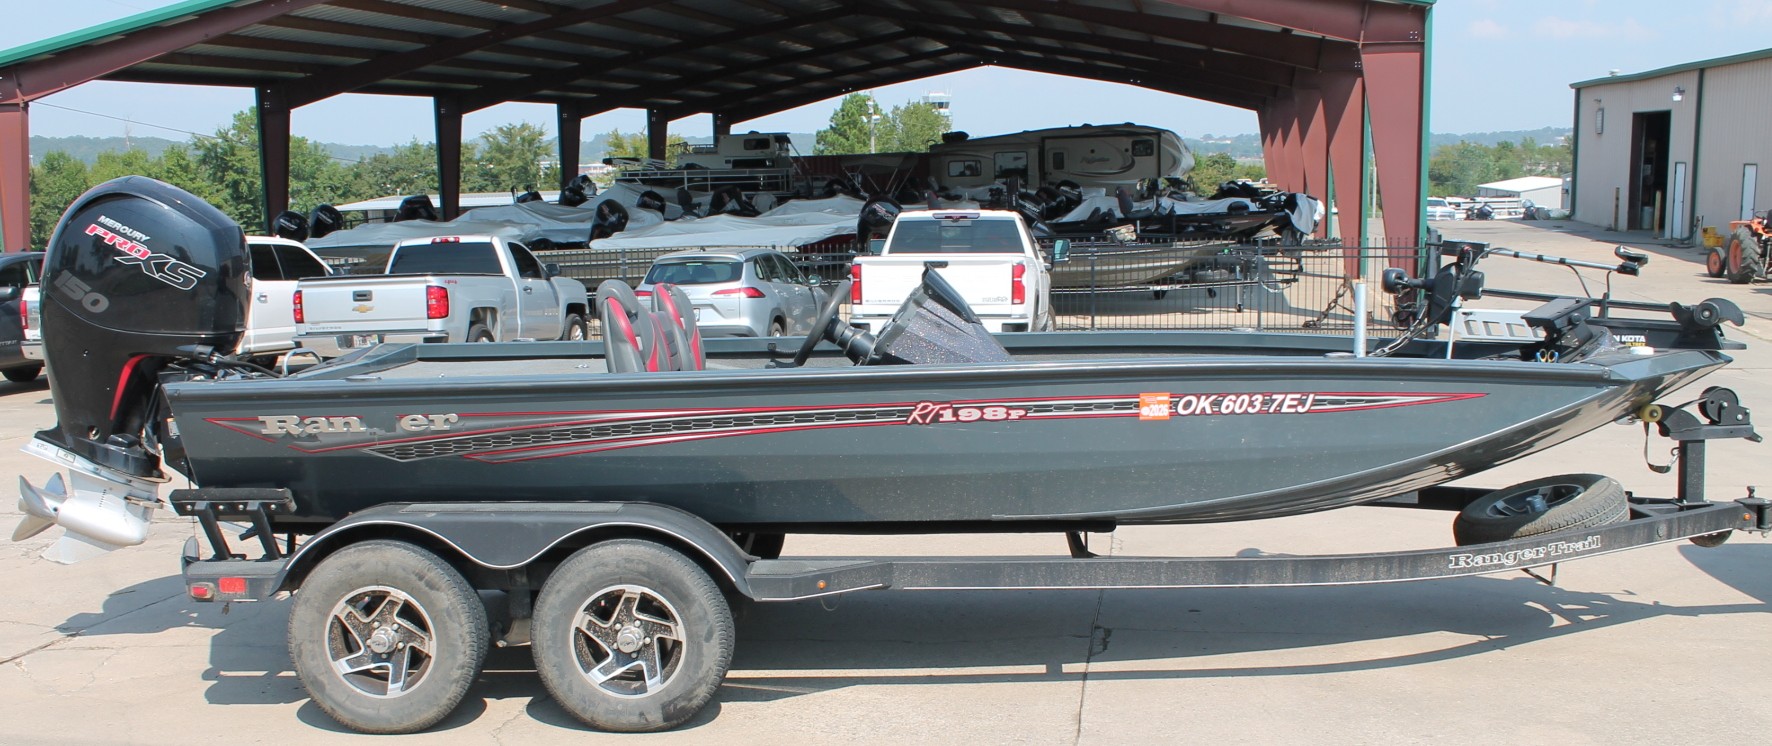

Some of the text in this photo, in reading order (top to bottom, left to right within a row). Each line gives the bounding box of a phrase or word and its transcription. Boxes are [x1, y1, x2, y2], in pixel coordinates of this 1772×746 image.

[85, 224, 151, 260] PRO
[98, 215, 150, 242] MERCURY
[54, 270, 109, 313] 150
[1176, 393, 1315, 416] OK 603 7EJ
[258, 411, 459, 435] Raner
[1449, 535, 1601, 569] Ranger Trail
